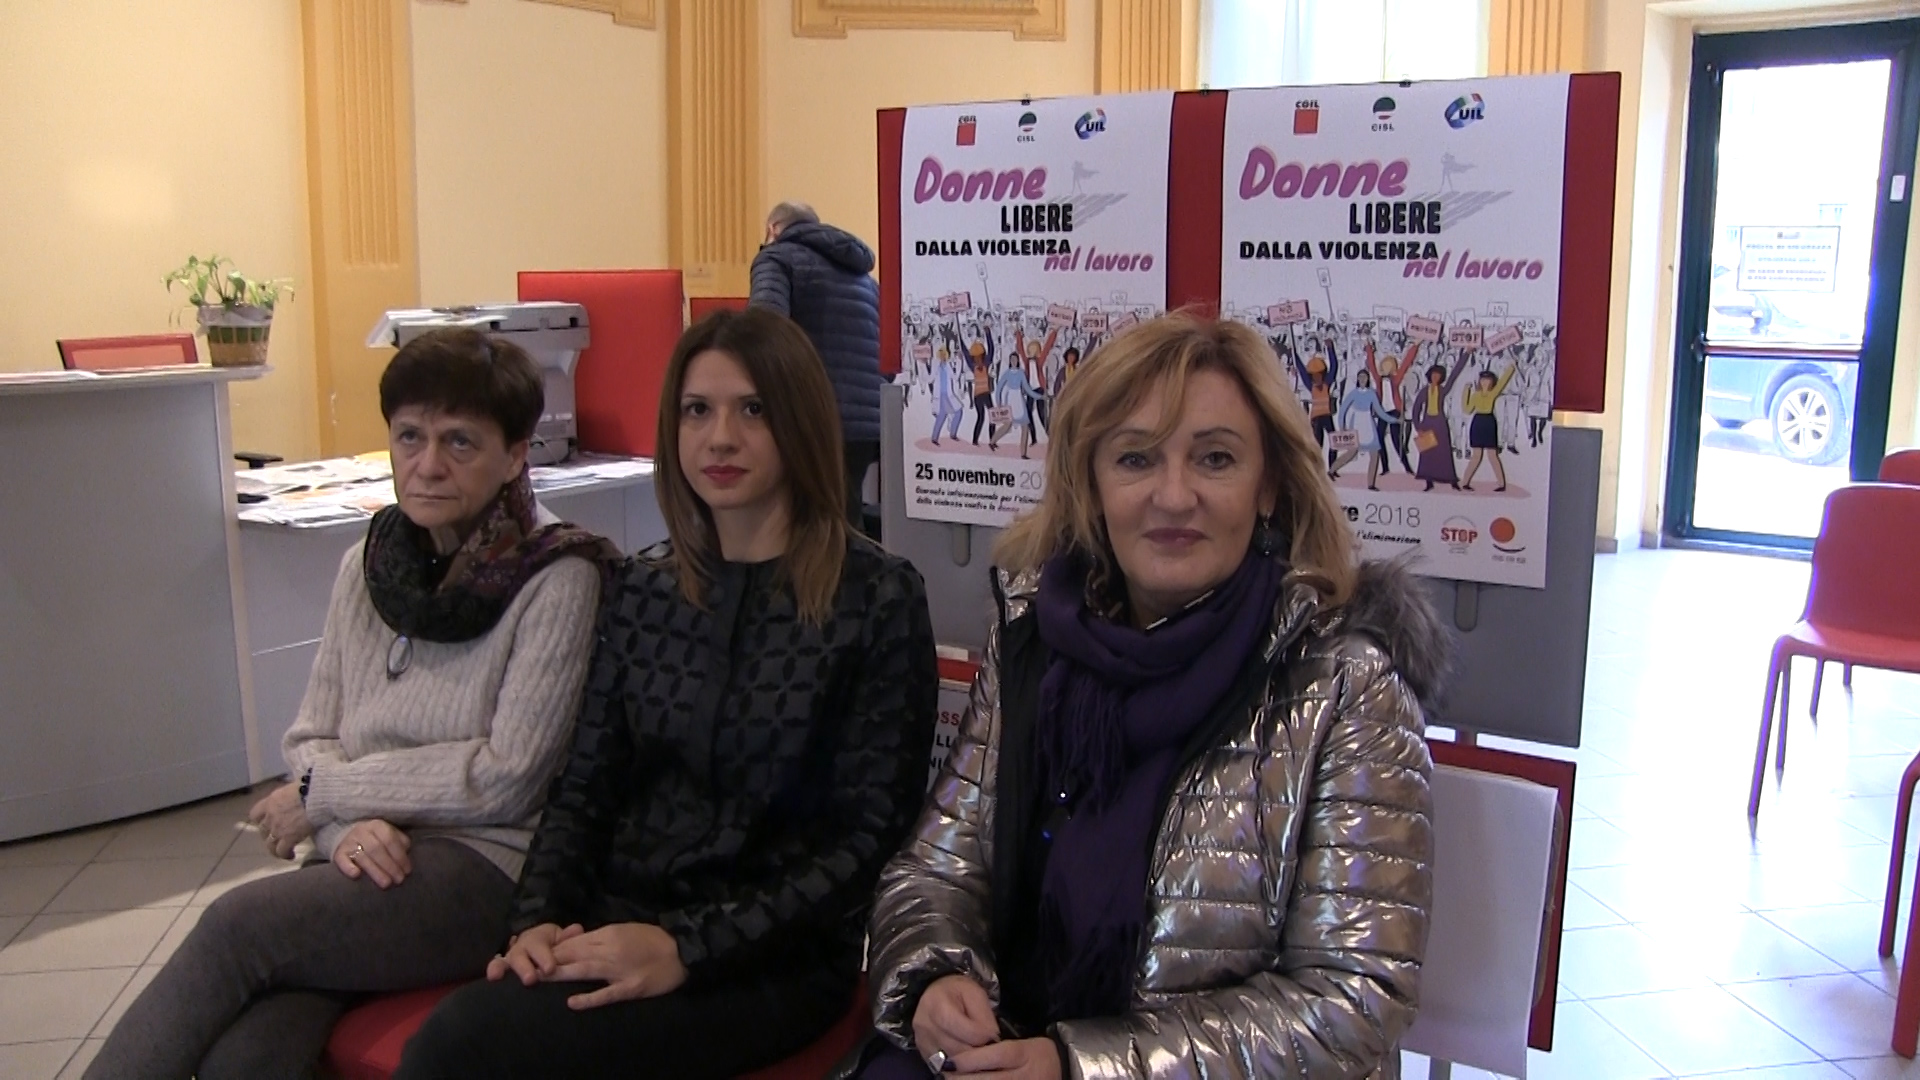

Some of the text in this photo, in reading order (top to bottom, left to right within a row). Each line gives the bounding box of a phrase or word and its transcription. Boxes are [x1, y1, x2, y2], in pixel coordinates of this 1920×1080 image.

[1294, 100, 1319, 108] CGIL
[958, 115, 977, 123] CGIL
[1459, 107, 1485, 121] UIL
[1086, 120, 1107, 132] UIL
[1371, 123, 1395, 131] CISL
[913, 155, 1048, 204] Donne
[1239, 145, 1411, 200] Donne
[1001, 203, 1073, 233] LIBERE
[1349, 201, 1441, 234] LIBERE
[915, 239, 1071, 256] DALLA VIOLENZA
[1239, 240, 1438, 259] DALLA VIOLENZA
[1043, 246, 1154, 272] nel lavoro
[1403, 249, 1544, 280] nel lavoro
[915, 463, 1042, 490] 25 novembre 20
[1365, 503, 1420, 528] 2018
[1356, 529, 1421, 544] l'eliminazione
[1441, 527, 1478, 543] STOP
